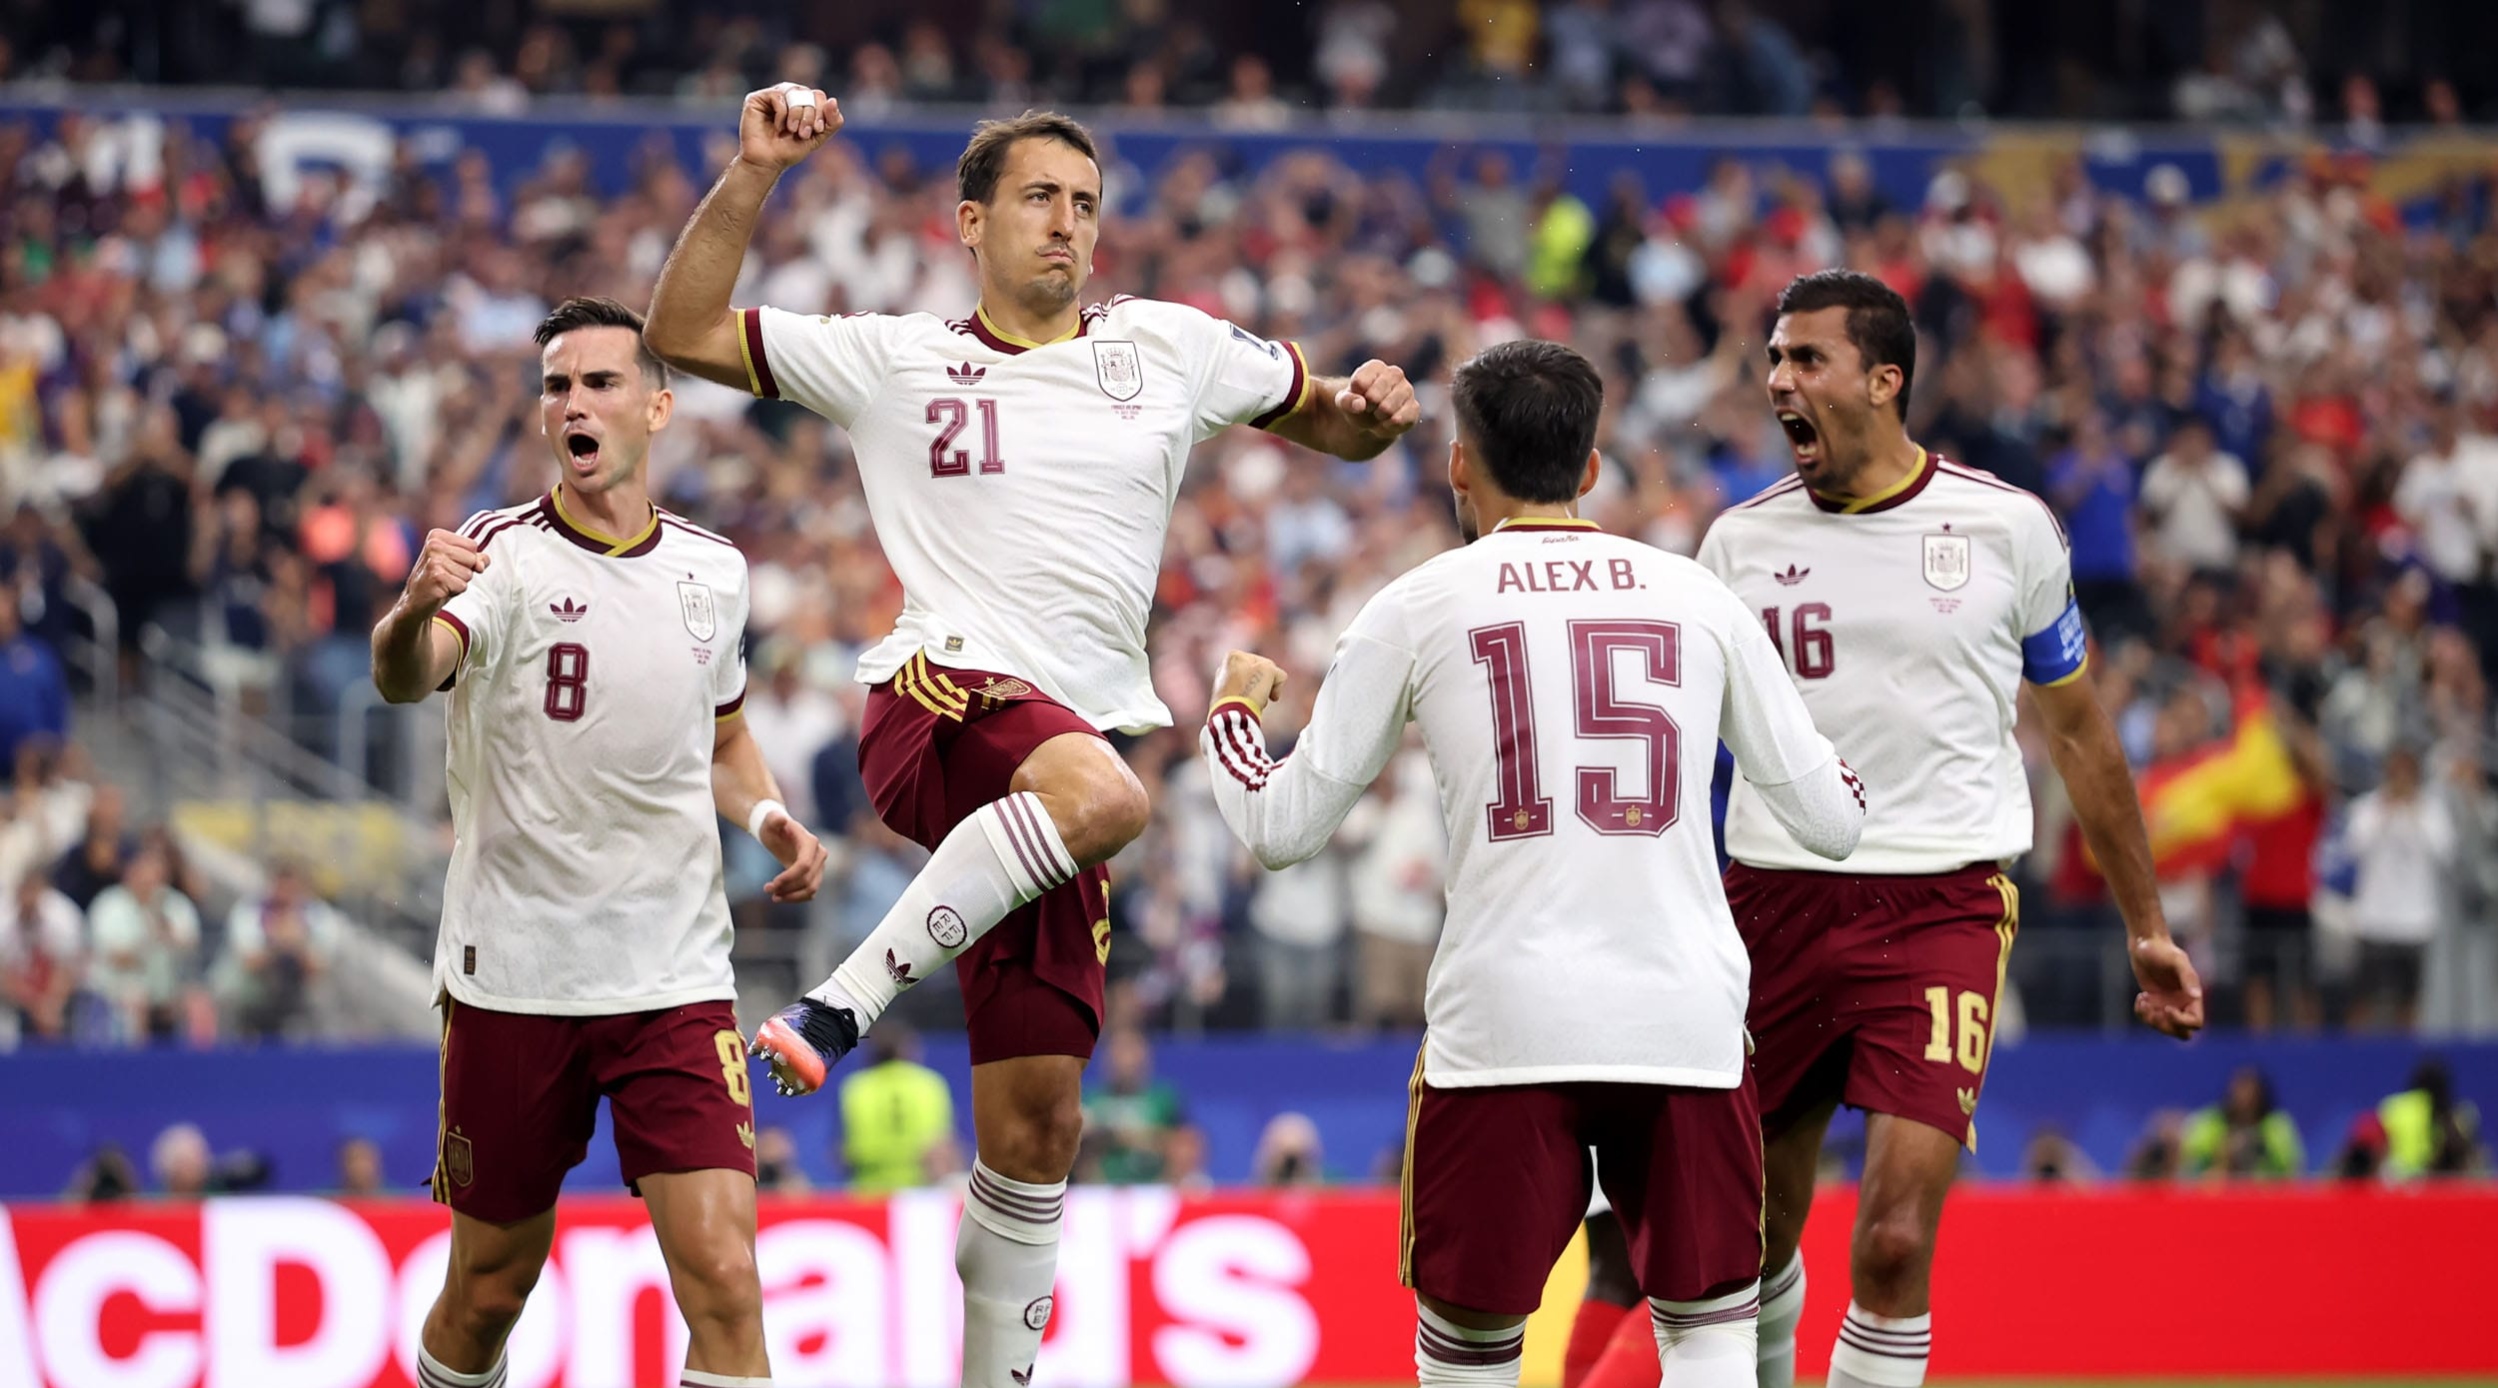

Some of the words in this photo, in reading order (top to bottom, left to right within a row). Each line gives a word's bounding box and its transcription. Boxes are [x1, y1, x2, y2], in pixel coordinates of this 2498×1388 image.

[925, 397, 1005, 478] 21
[1497, 560, 1599, 594] ALEX
[1608, 559, 1647, 590] B.
[543, 641, 590, 723] 8
[1468, 619, 1681, 843] 15
[714, 1028, 751, 1109] 8
[1924, 986, 1989, 1076] 16
